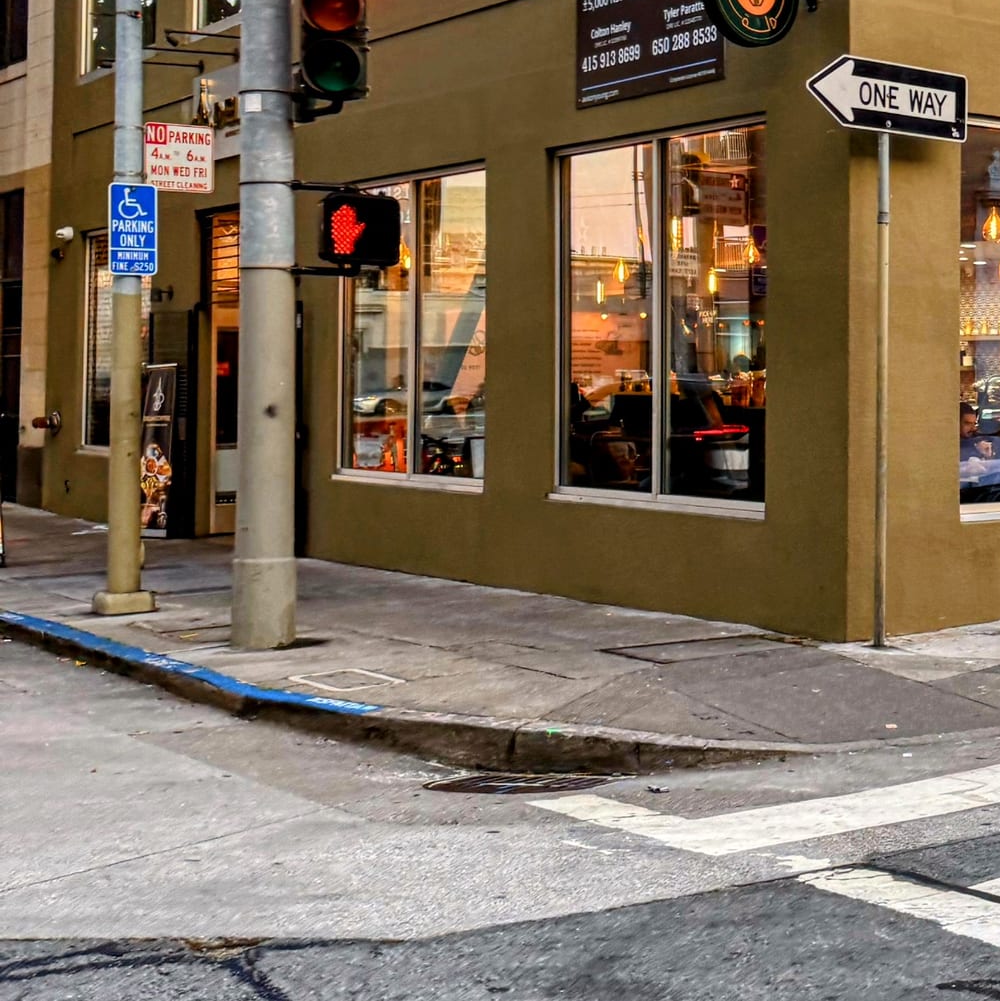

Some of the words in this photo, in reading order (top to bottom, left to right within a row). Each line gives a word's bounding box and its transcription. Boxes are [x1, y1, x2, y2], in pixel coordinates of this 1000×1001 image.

[663, 7, 680, 23] Tyler
[652, 37, 670, 56] 650
[672, 32, 690, 51] 288
[692, 25, 717, 46] 8533
[582, 55, 598, 73] 415
[600, 50, 616, 69] 913
[618, 44, 641, 63] 8699
[859, 81, 899, 110] ONE
[909, 88, 947, 116] WAY
[146, 125, 166, 143] NO
[169, 131, 211, 145] PARKING
[151, 165, 170, 176] MON
[173, 166, 190, 177] WED
[193, 167, 207, 178] FRI
[112, 219, 154, 233] PARKING
[120, 234, 146, 248] ONLY
[117, 251, 149, 260] MINIMUM
[112, 262, 128, 270] FINE
